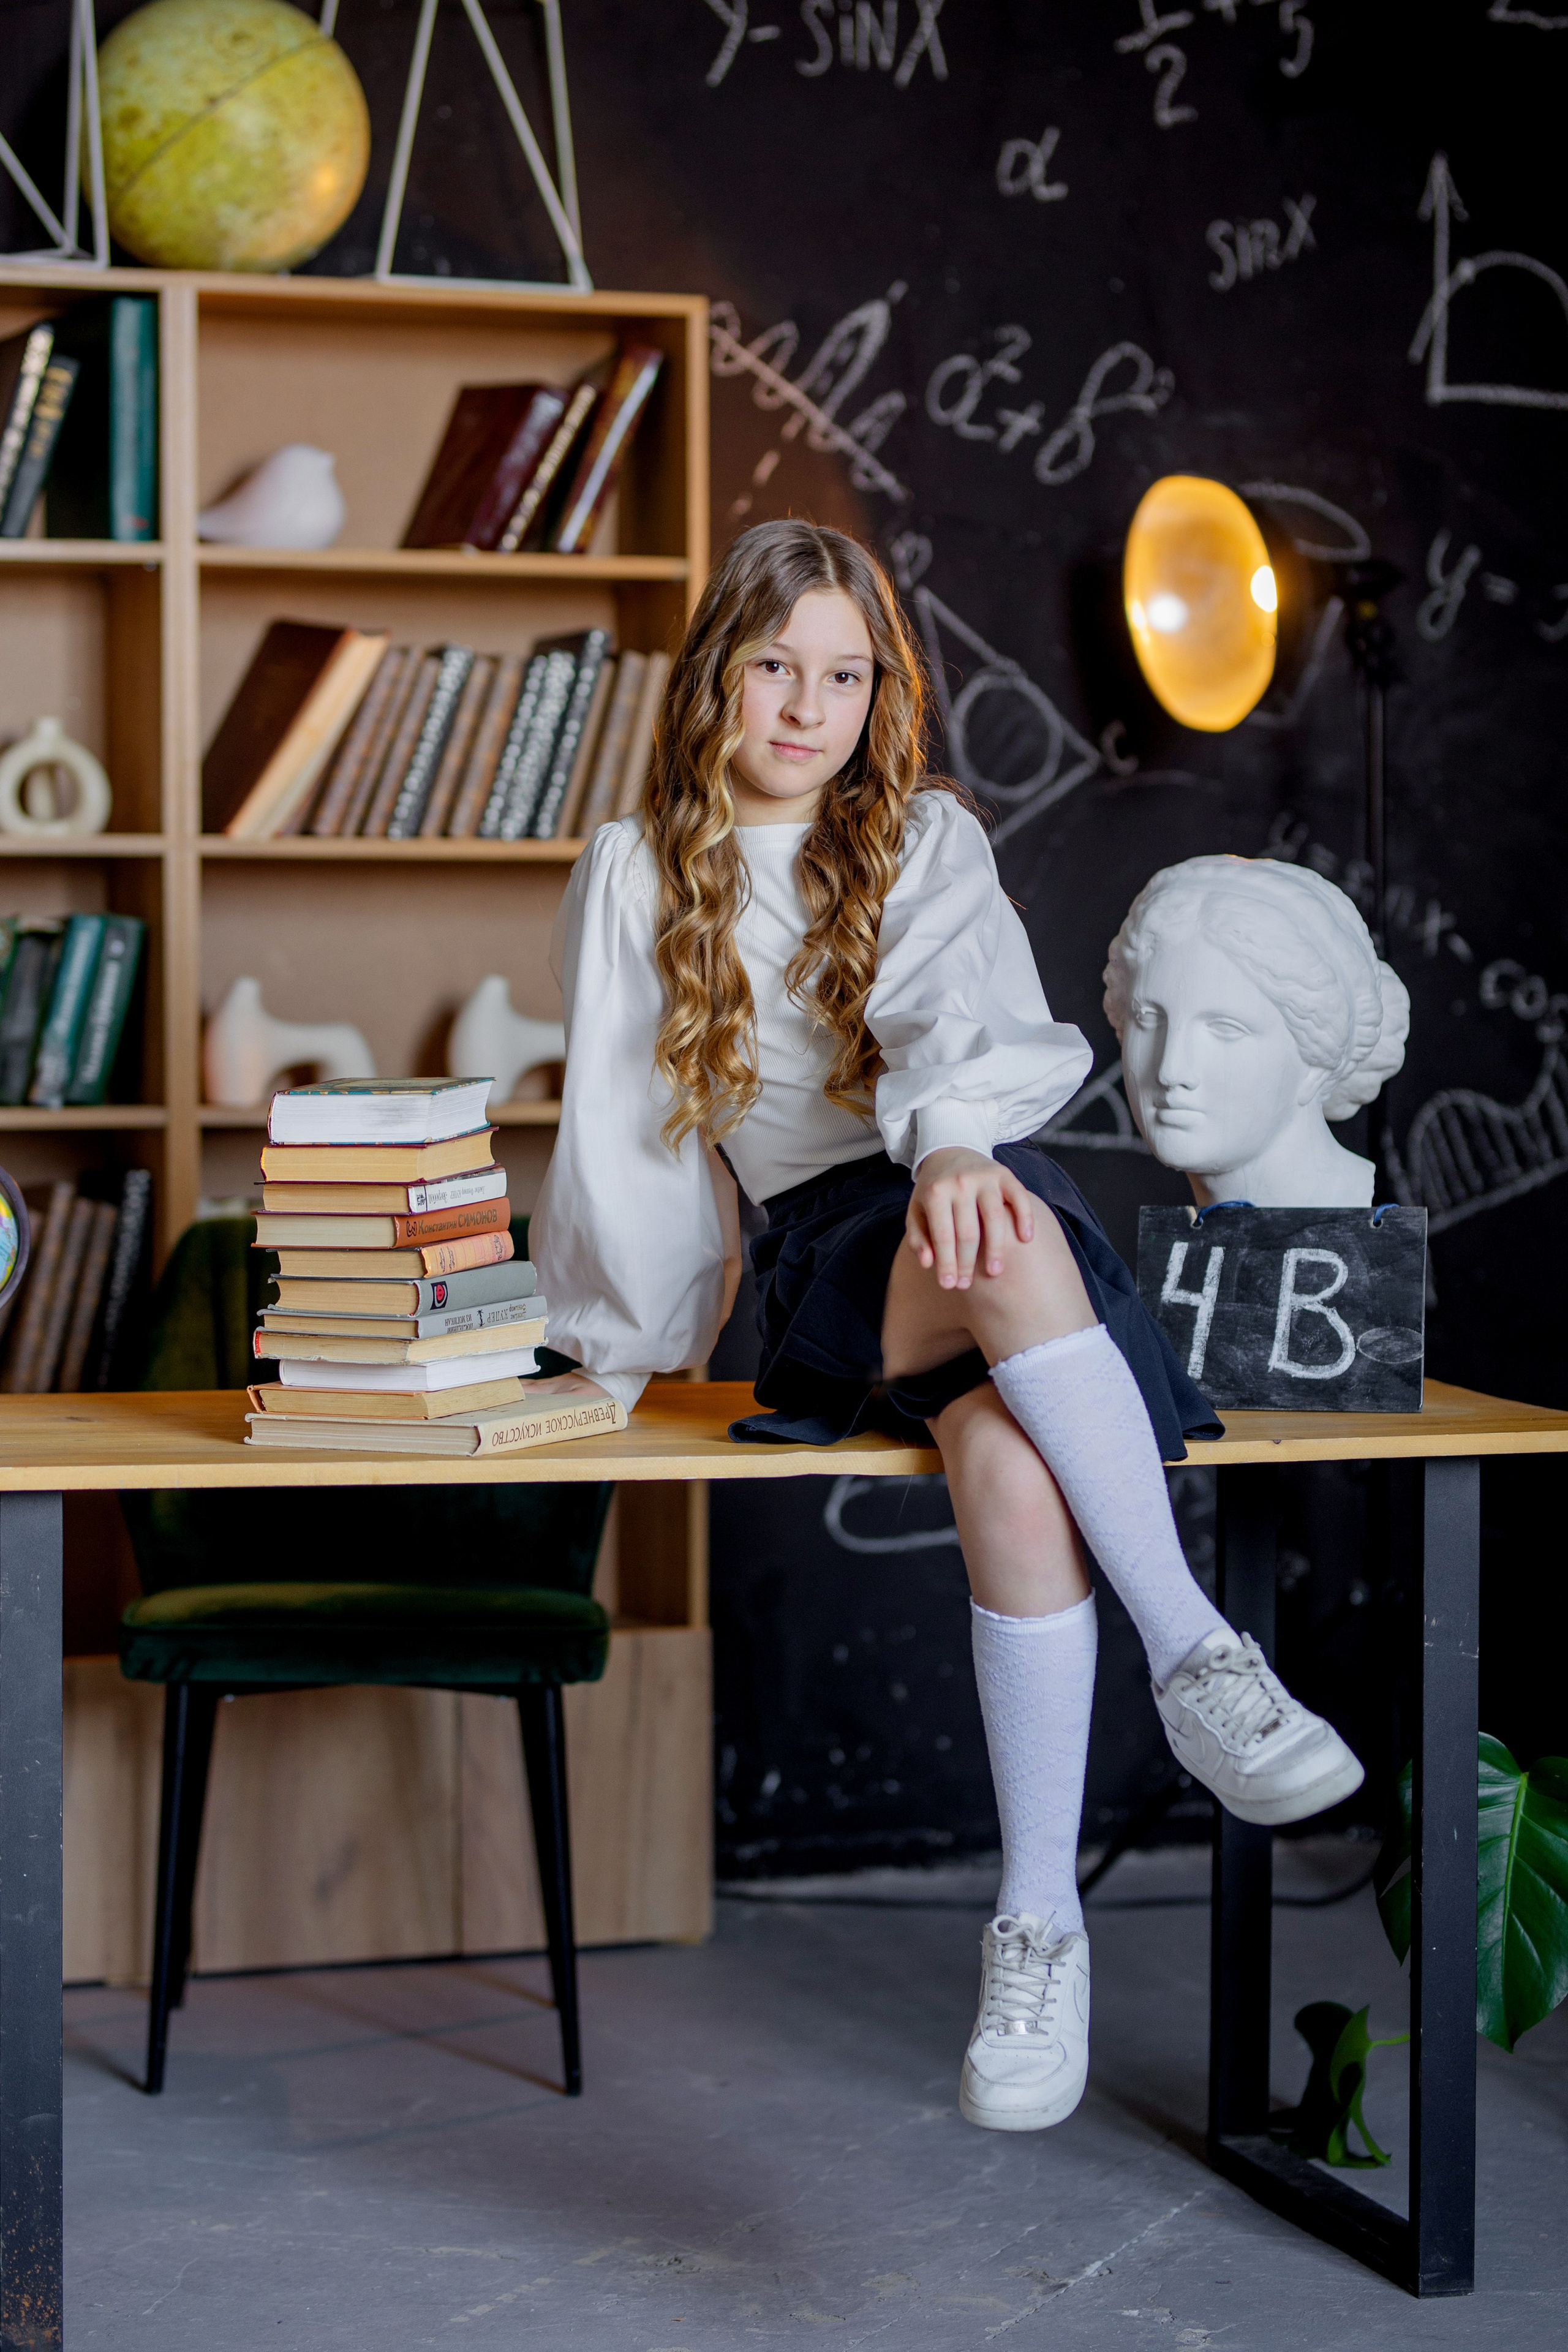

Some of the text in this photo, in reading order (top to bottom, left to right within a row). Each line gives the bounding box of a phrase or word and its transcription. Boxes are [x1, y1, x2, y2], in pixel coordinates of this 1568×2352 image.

[418, 1219, 457, 1234] Константин
[458, 1208, 497, 1227] СИМОНОВ
[445, 1315, 466, 1327] МОГИКАН
[487, 1309, 508, 1323] КУПЕР
[1161, 1241, 1226, 1381] 4
